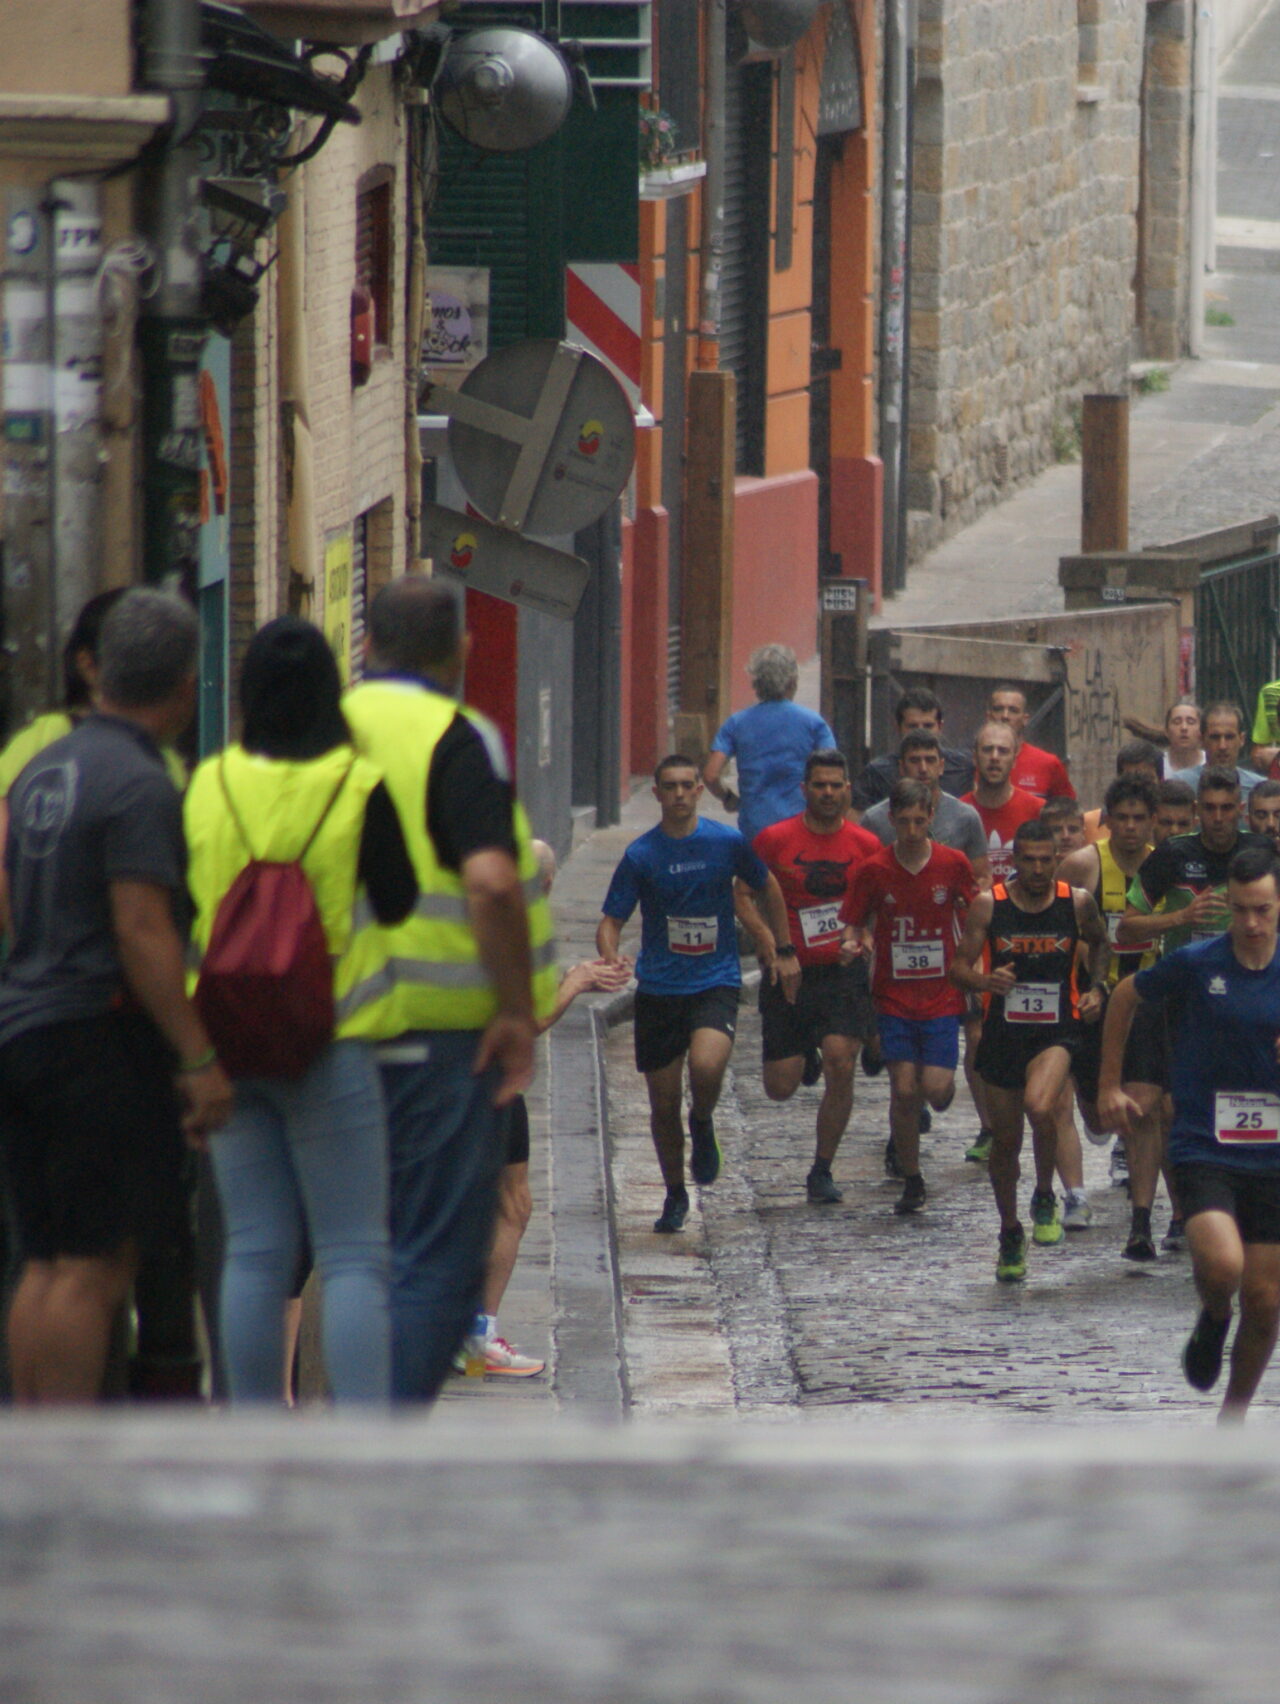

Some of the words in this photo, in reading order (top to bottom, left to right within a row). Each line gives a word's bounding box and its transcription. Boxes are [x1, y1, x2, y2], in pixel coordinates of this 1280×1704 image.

[817, 918, 838, 933] 26
[683, 932, 702, 945] 11
[907, 955, 930, 969] 38
[1021, 998, 1044, 1013] 13
[1235, 1111, 1263, 1129] 25
